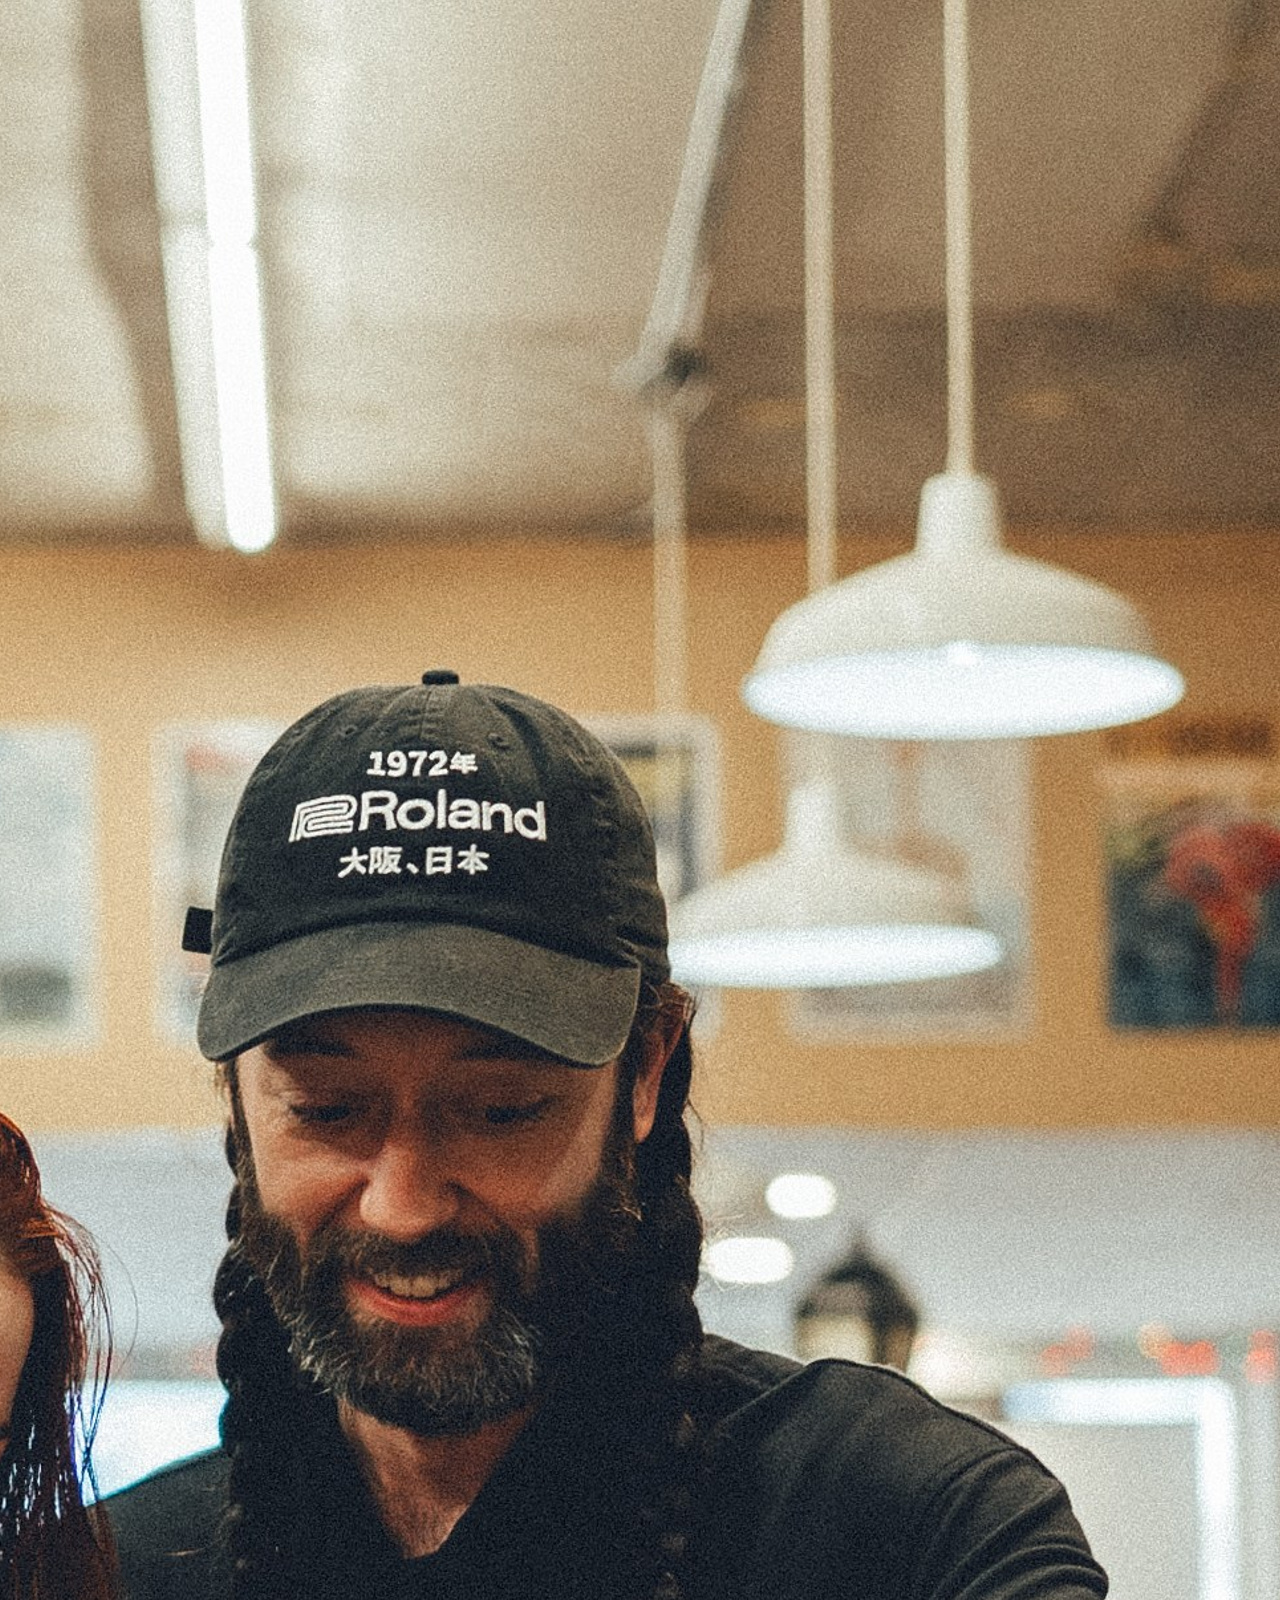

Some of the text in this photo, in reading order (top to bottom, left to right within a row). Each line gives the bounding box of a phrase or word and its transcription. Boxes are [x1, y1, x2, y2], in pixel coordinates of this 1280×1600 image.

[366, 750, 478, 777] 1972年
[358, 788, 547, 841] Roland
[337, 844, 490, 878] 大阪、日本
